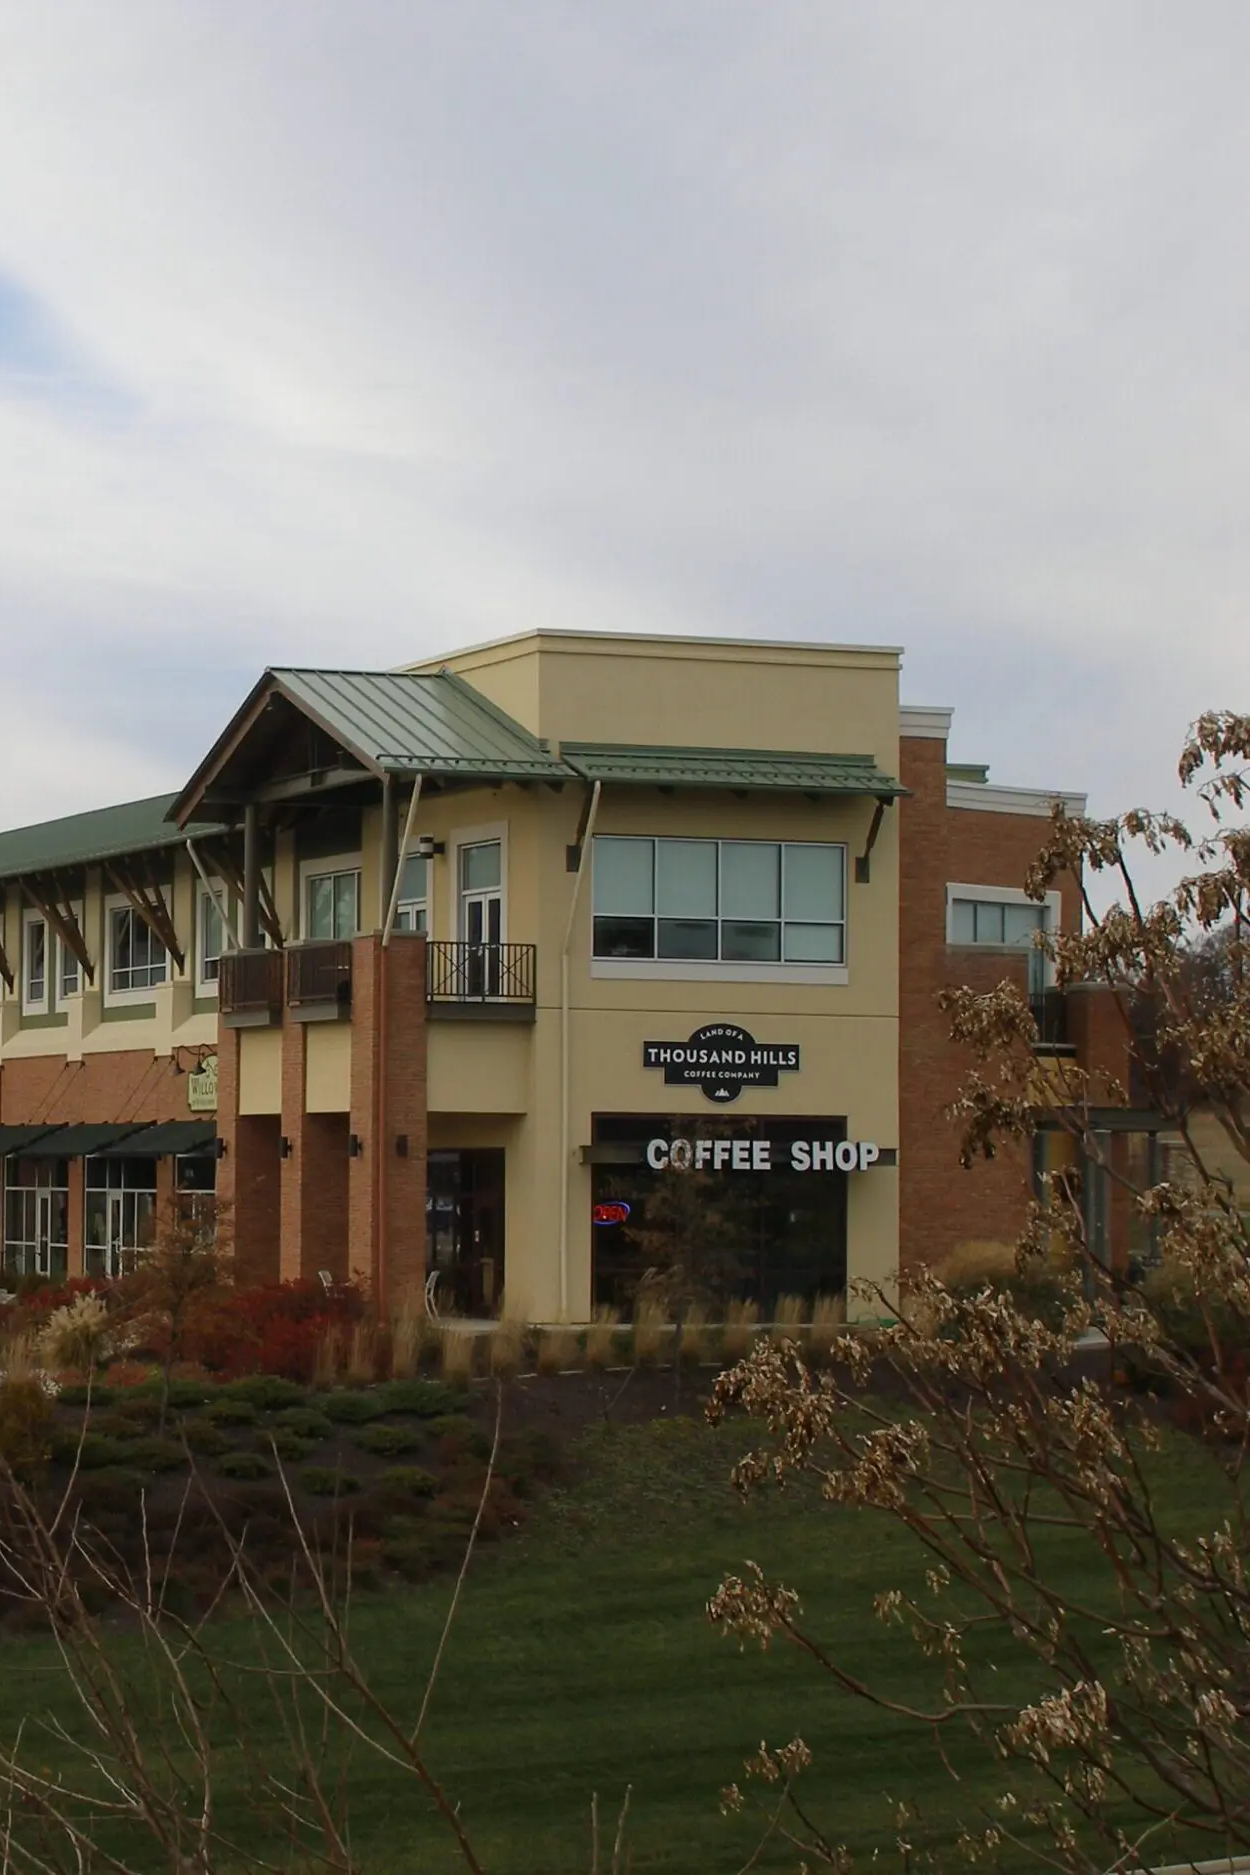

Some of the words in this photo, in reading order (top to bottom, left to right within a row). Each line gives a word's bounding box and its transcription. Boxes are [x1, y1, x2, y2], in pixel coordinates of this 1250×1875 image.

[700, 1028, 724, 1041] LAND
[725, 1028, 738, 1037] OF
[737, 1033, 745, 1041] A
[648, 1048, 746, 1064] THOUSAND
[751, 1050, 797, 1066] HILLS
[683, 1070, 717, 1079] COFFEE
[718, 1071, 761, 1080] COMPANY
[646, 1138, 771, 1170] COFFEE
[790, 1141, 880, 1171] SHOP
[593, 1204, 627, 1222] OPEN
